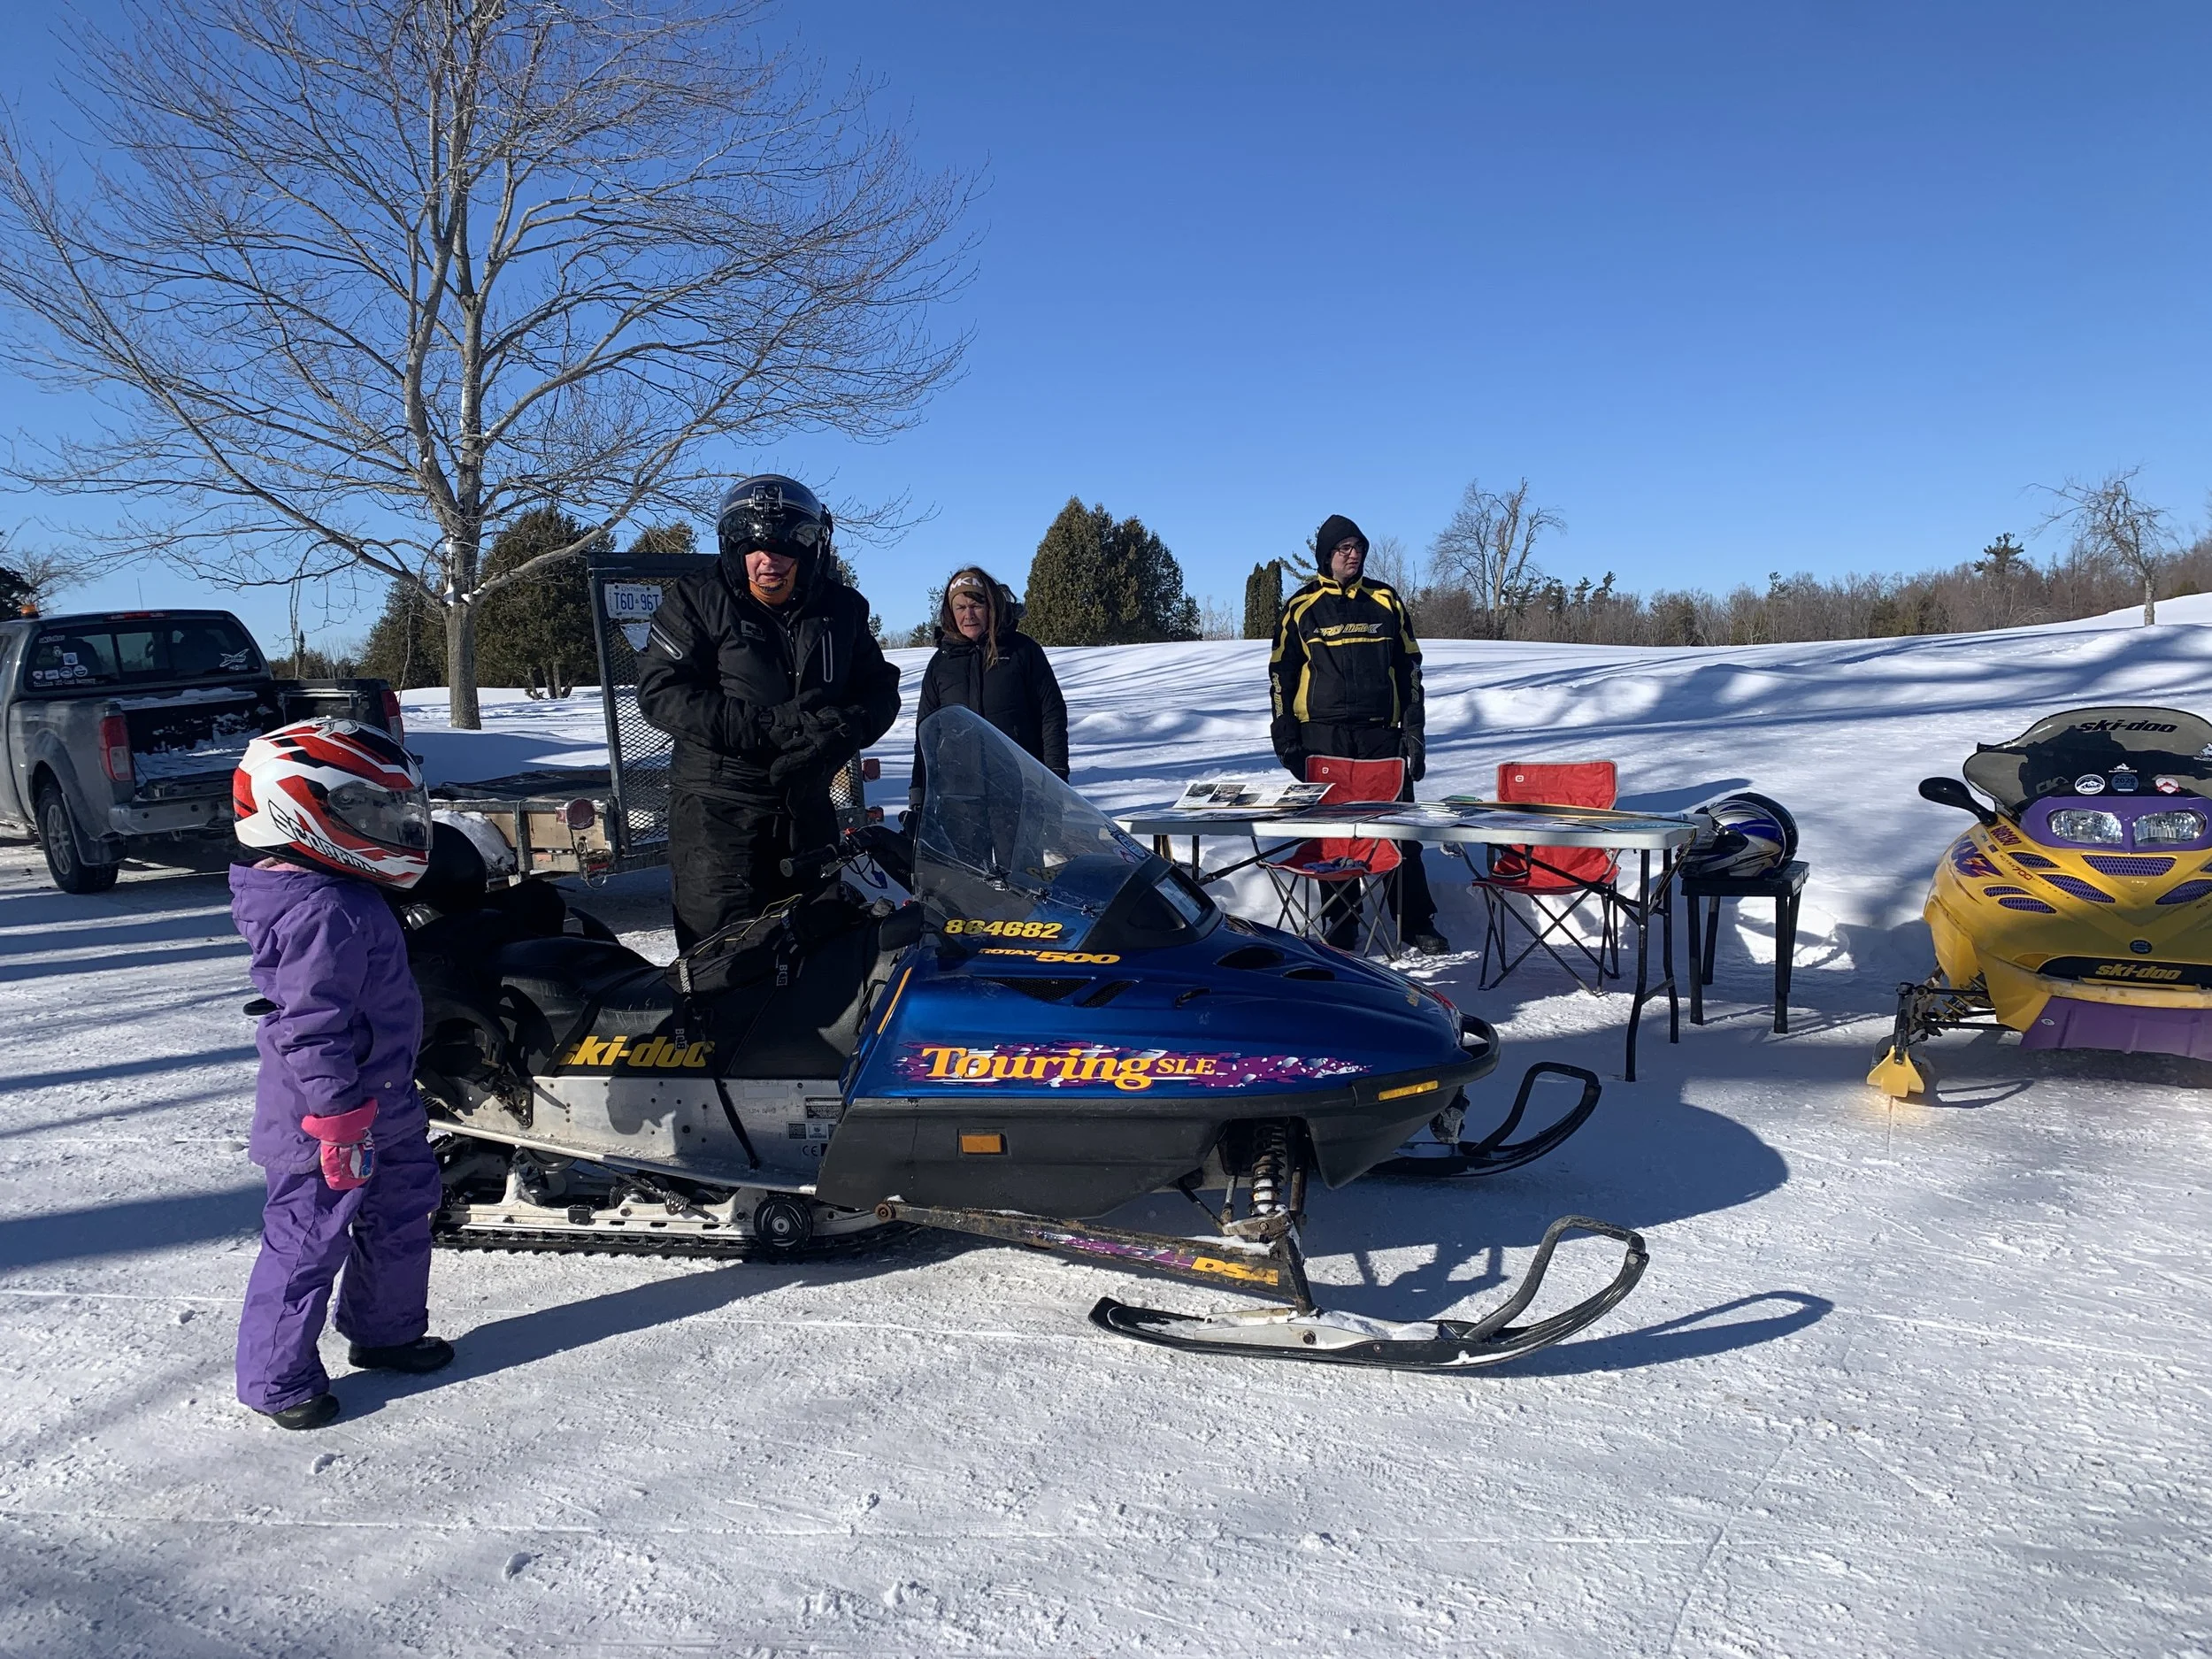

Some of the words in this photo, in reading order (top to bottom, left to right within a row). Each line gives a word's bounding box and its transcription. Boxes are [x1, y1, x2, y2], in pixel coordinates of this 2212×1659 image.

[2076, 718, 2178, 733] ski-doo
[2012, 866, 2034, 881] 700
[943, 918, 1064, 940] 864682
[1035, 951, 1122, 964] 500
[2094, 963, 2183, 980] ski-doo
[921, 1047, 1153, 1091] Touring
[1155, 1057, 1218, 1076] SLE
